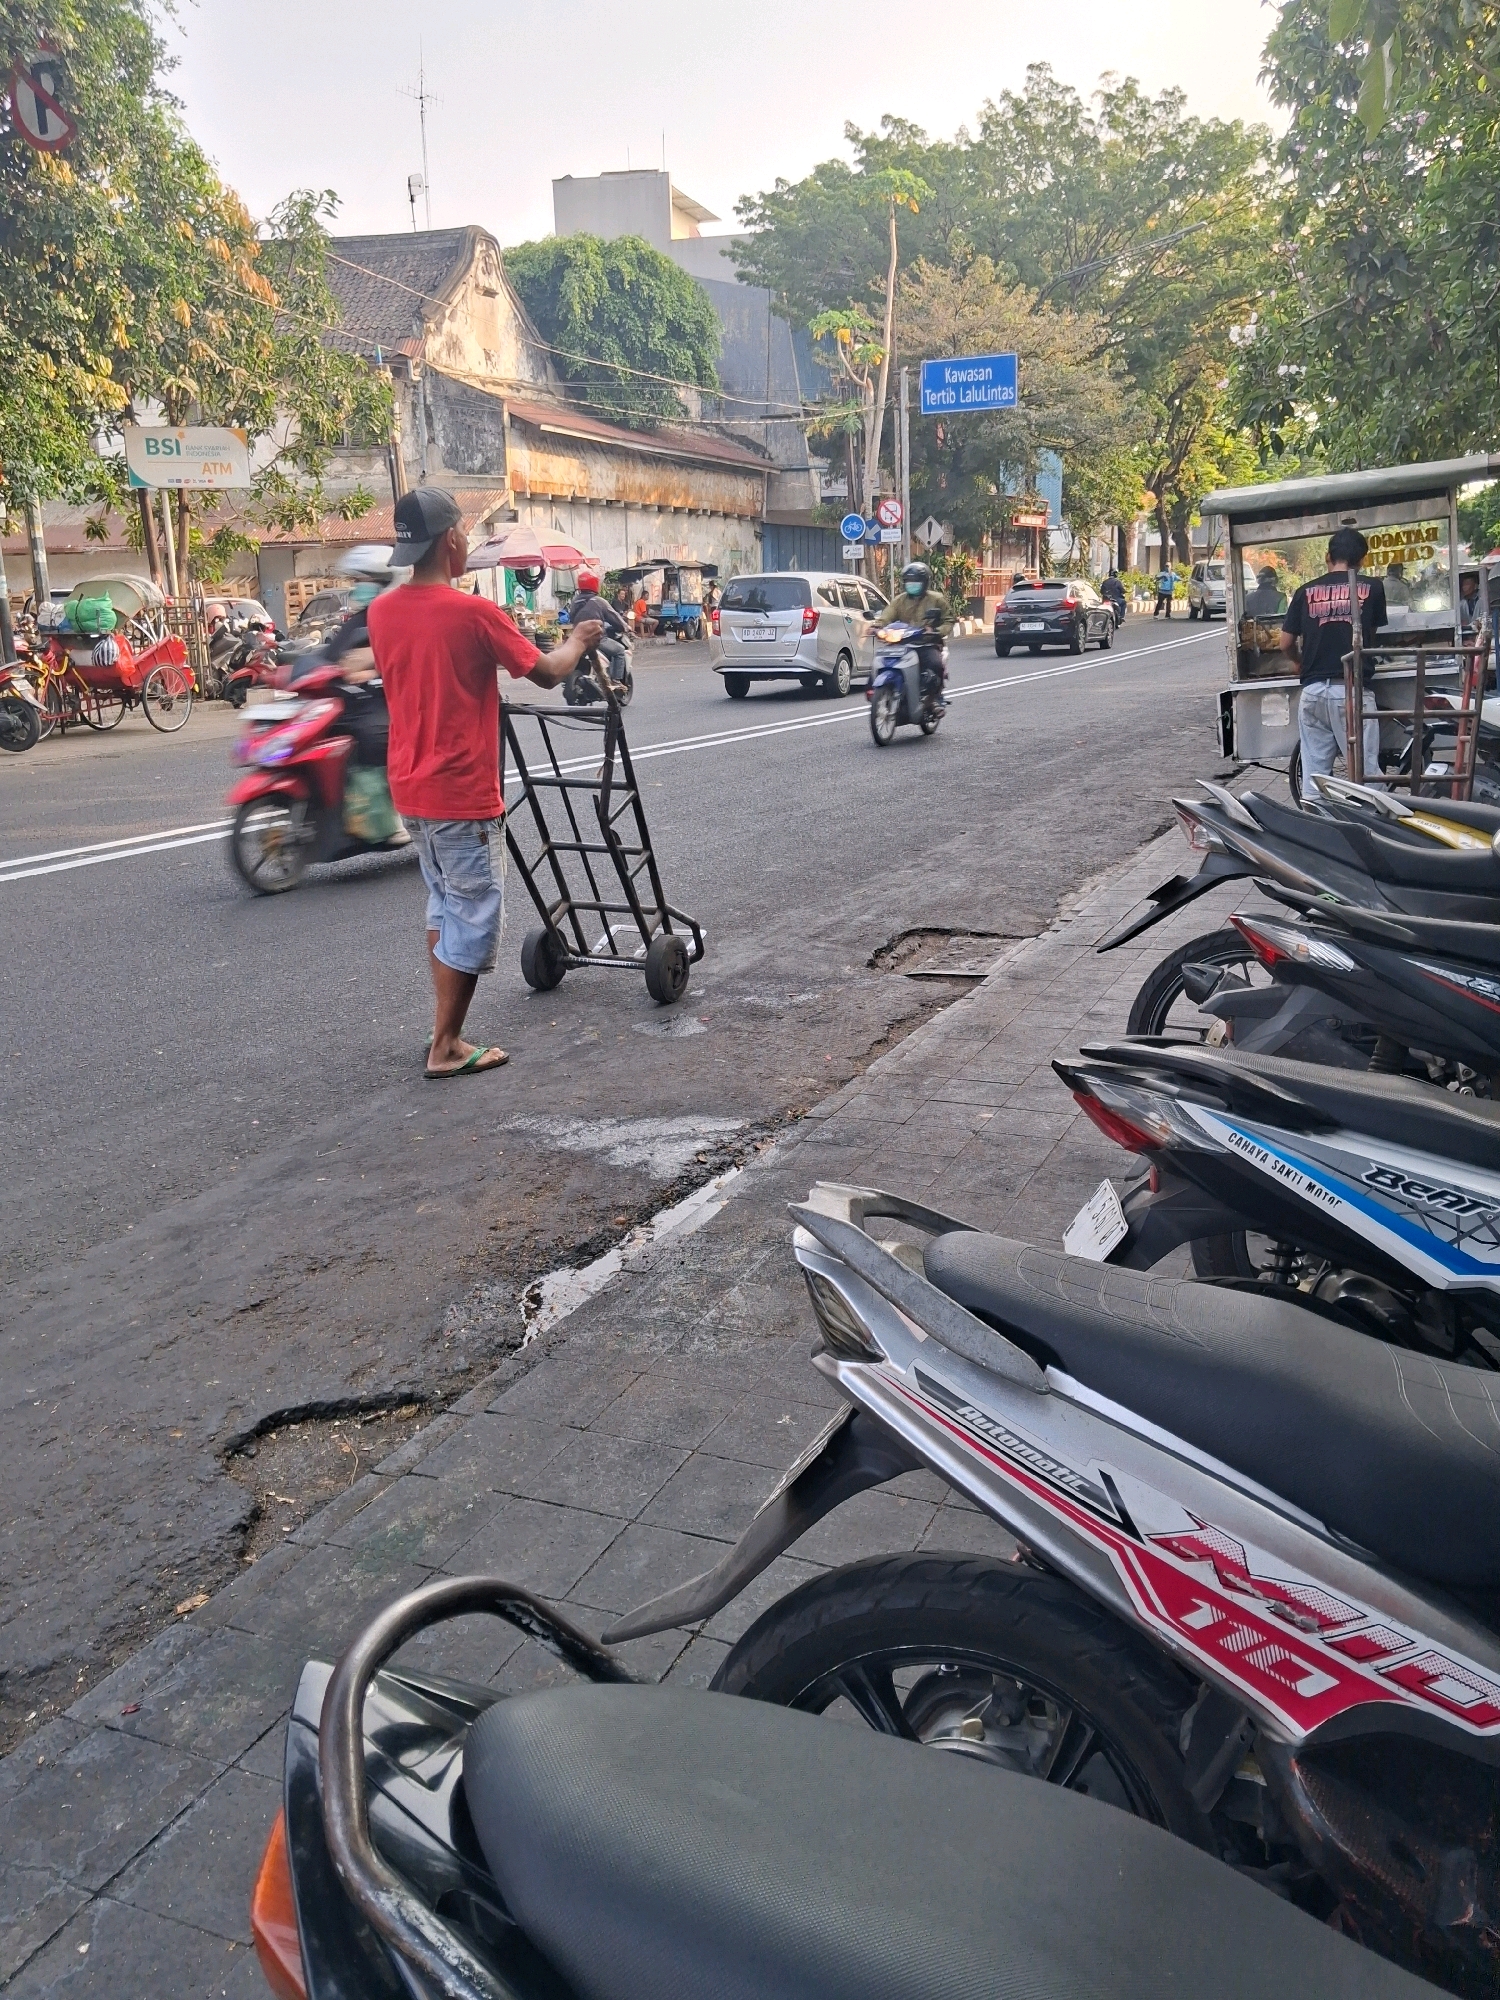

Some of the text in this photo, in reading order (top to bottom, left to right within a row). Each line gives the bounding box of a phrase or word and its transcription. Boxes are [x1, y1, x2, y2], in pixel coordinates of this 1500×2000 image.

[945, 367, 992, 383] Kawasan
[925, 385, 1014, 405] Tertib LaluLintas
[145, 438, 181, 456] BSI
[202, 462, 232, 475] ATM
[1331, 582, 1371, 601] KNW
[1416, 820, 1440, 830] YAMAHA
[1228, 1132, 1269, 1164] CAHAYA
[1271, 1160, 1303, 1185] SAKTI
[956, 1405, 1090, 1491] Automatic
